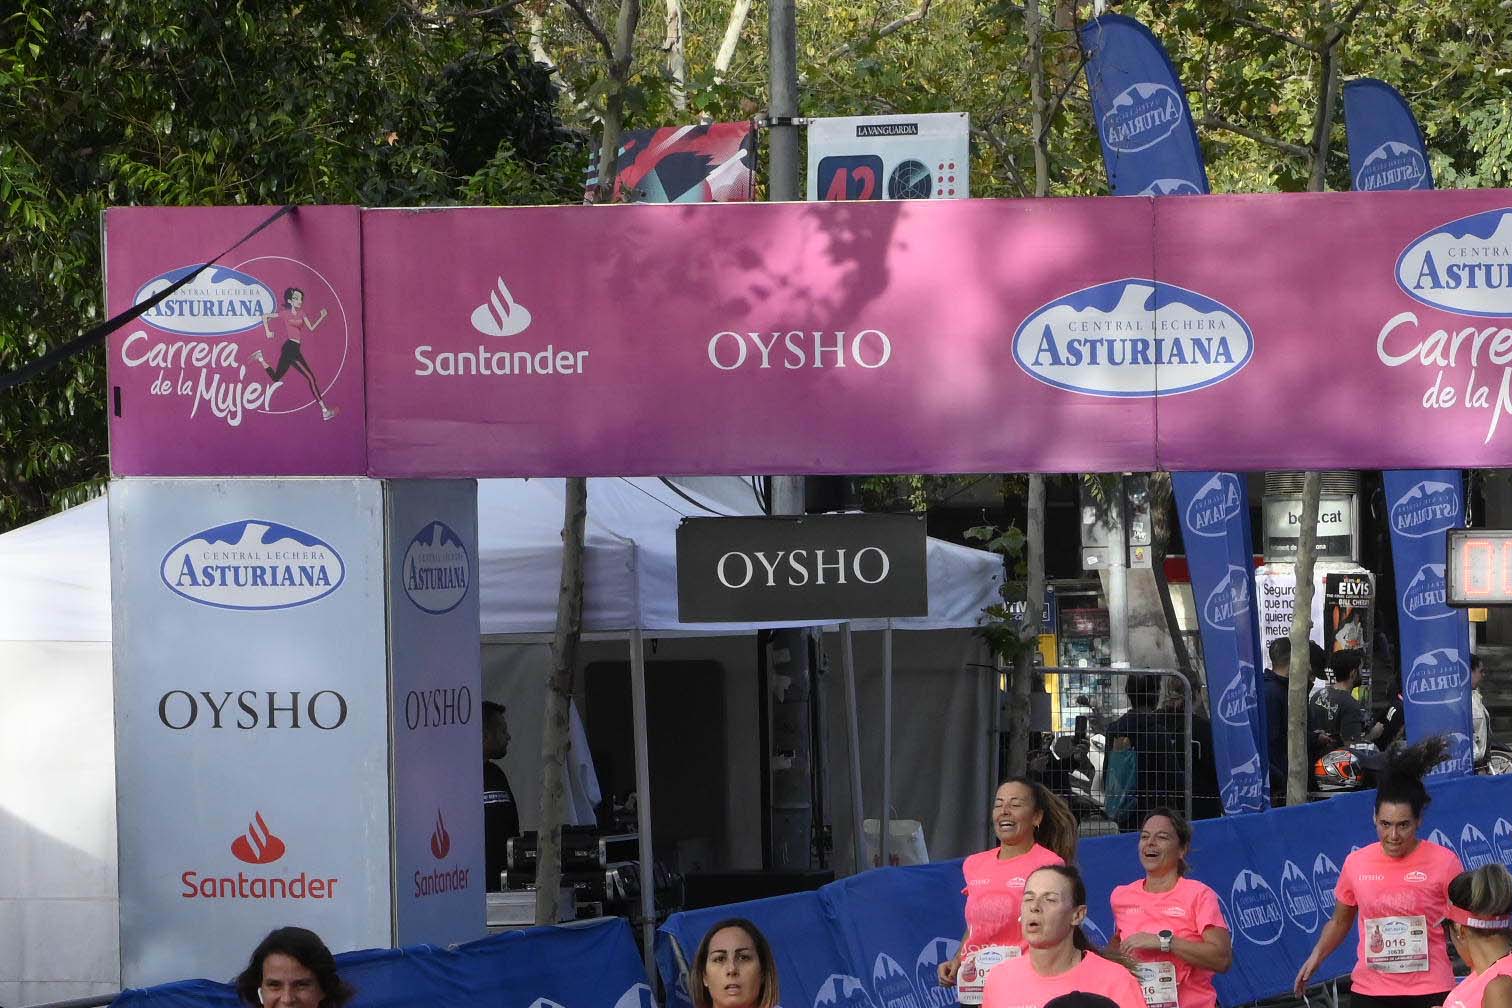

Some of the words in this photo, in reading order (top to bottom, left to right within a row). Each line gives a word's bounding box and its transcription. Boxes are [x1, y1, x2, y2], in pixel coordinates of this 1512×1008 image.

[867, 125, 917, 136] VANGUARDIA
[215, 288, 262, 296] LECHERA
[1068, 319, 1142, 332] CENTRAL
[1151, 319, 1228, 332] LECHERA
[122, 331, 240, 368] Carrera
[414, 344, 589, 376] Santander
[707, 329, 892, 371] OYSHO
[1031, 323, 1235, 367] ASTURIANA
[150, 370, 173, 396] de
[178, 369, 193, 396] la
[191, 364, 283, 427] Mujer
[1423, 371, 1457, 409] de
[1464, 369, 1491, 409] la
[1288, 510, 1342, 525] b.cat
[176, 553, 331, 587] ASTURIANA
[203, 551, 261, 561] CENTRAL
[267, 551, 326, 560] LECHERA
[717, 547, 891, 589] OYSHO
[408, 557, 466, 591] ASTURIANA
[1339, 581, 1370, 595] ELVIS
[1264, 599, 1280, 610] que
[1265, 610, 1293, 623] quiere
[1265, 624, 1291, 636] mete
[158, 690, 348, 730] OYSHO
[405, 685, 471, 731] OYSHO
[182, 871, 338, 899] Santander
[414, 865, 470, 898] Santander
[1385, 938, 1406, 948] 016
